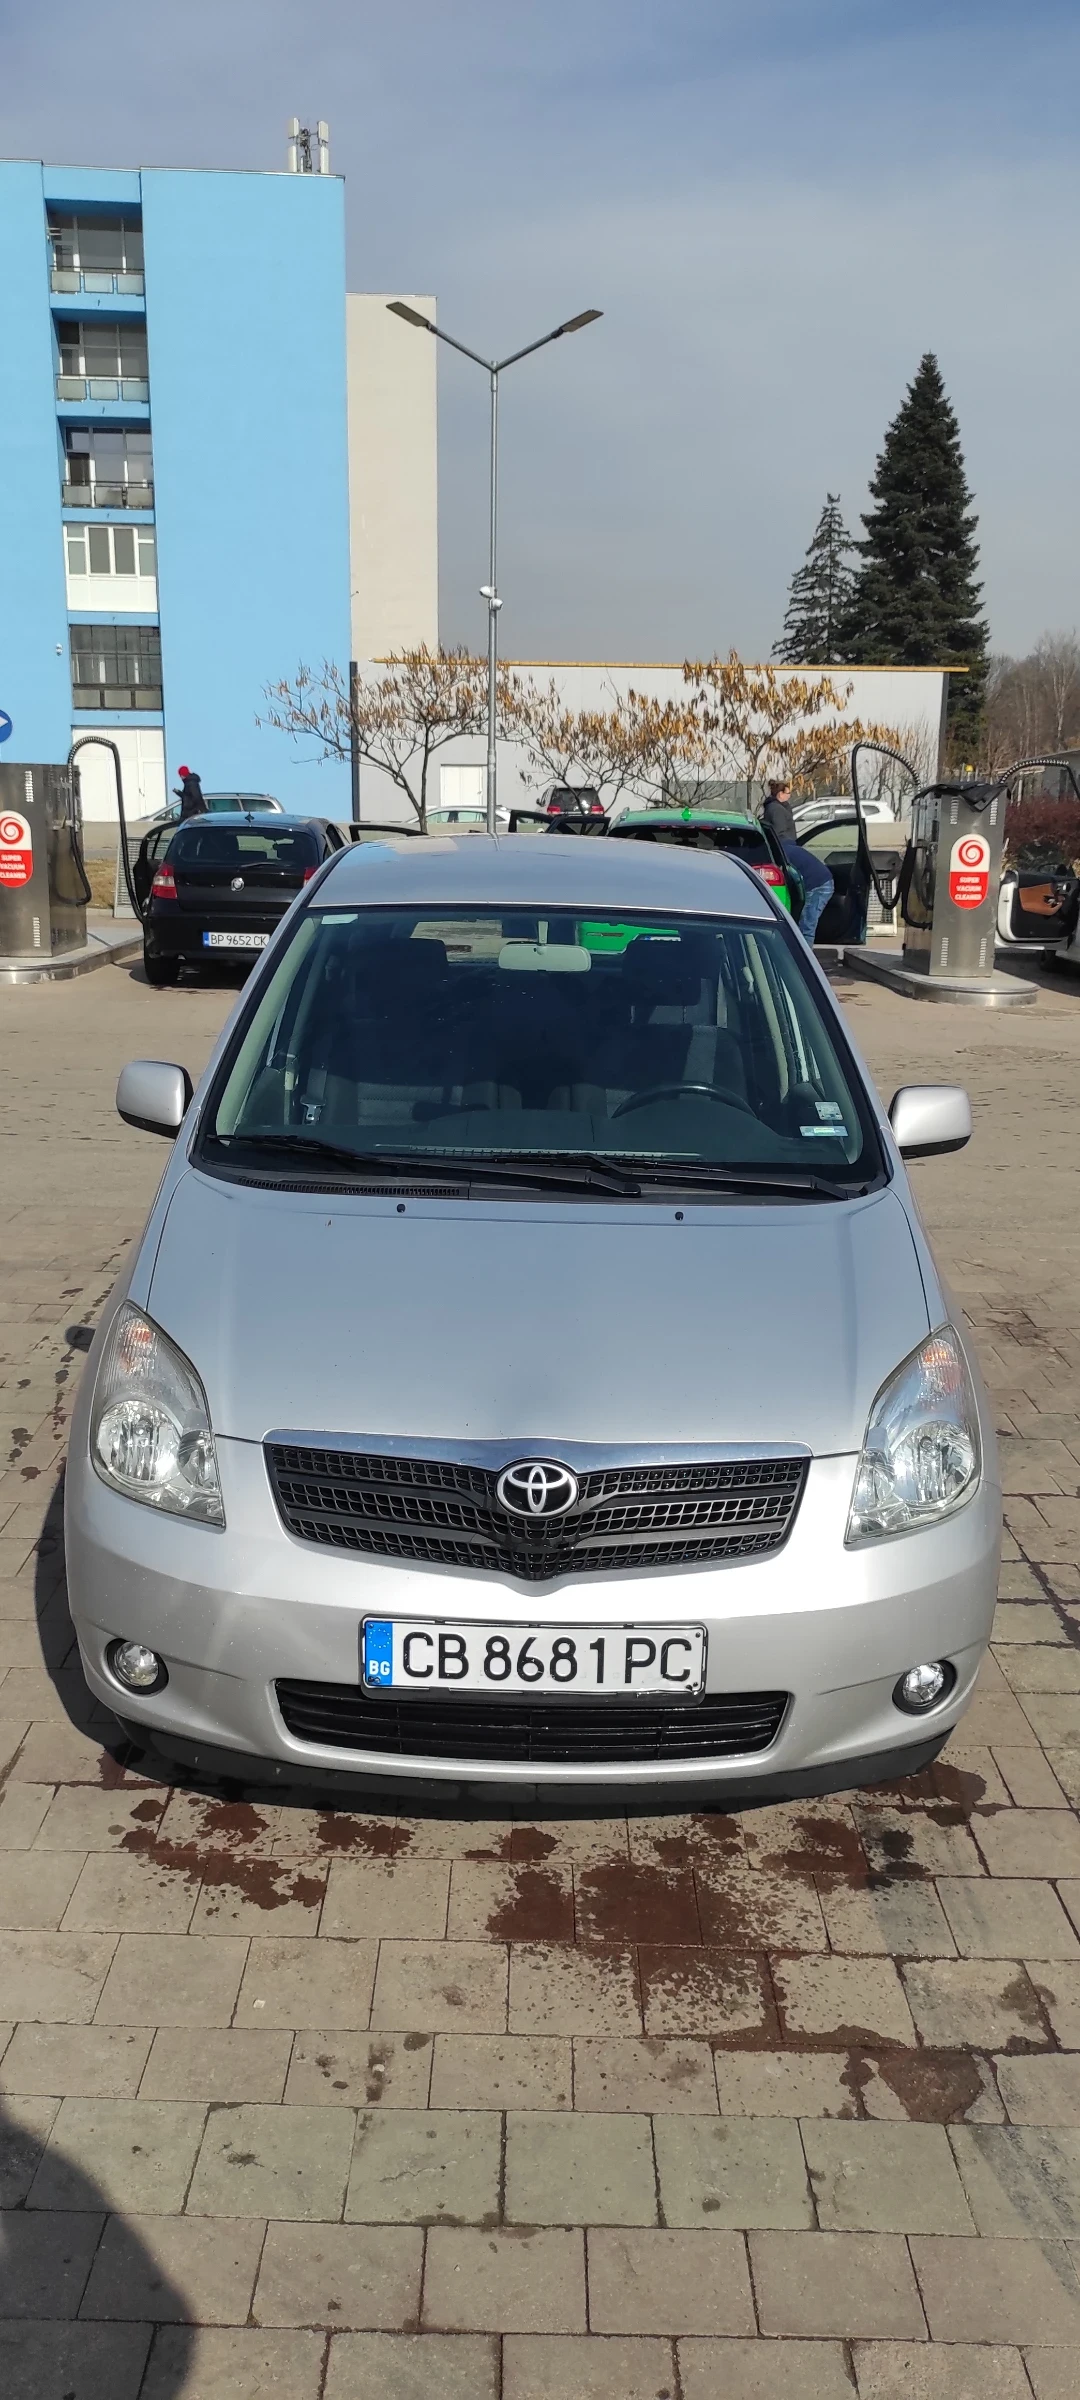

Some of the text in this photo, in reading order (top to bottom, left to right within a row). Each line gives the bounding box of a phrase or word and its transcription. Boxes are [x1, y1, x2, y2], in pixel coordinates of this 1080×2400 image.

[1, 854, 22, 862] SUPER
[959, 876, 981, 884] SUPER
[954, 893, 983, 901] CLEANER
[210, 934, 224, 945] BP
[226, 935, 252, 946] 9652
[253, 935, 268, 947] CK
[402, 1631, 693, 1684] CB 8681 PC
[368, 1659, 391, 1677] BG
